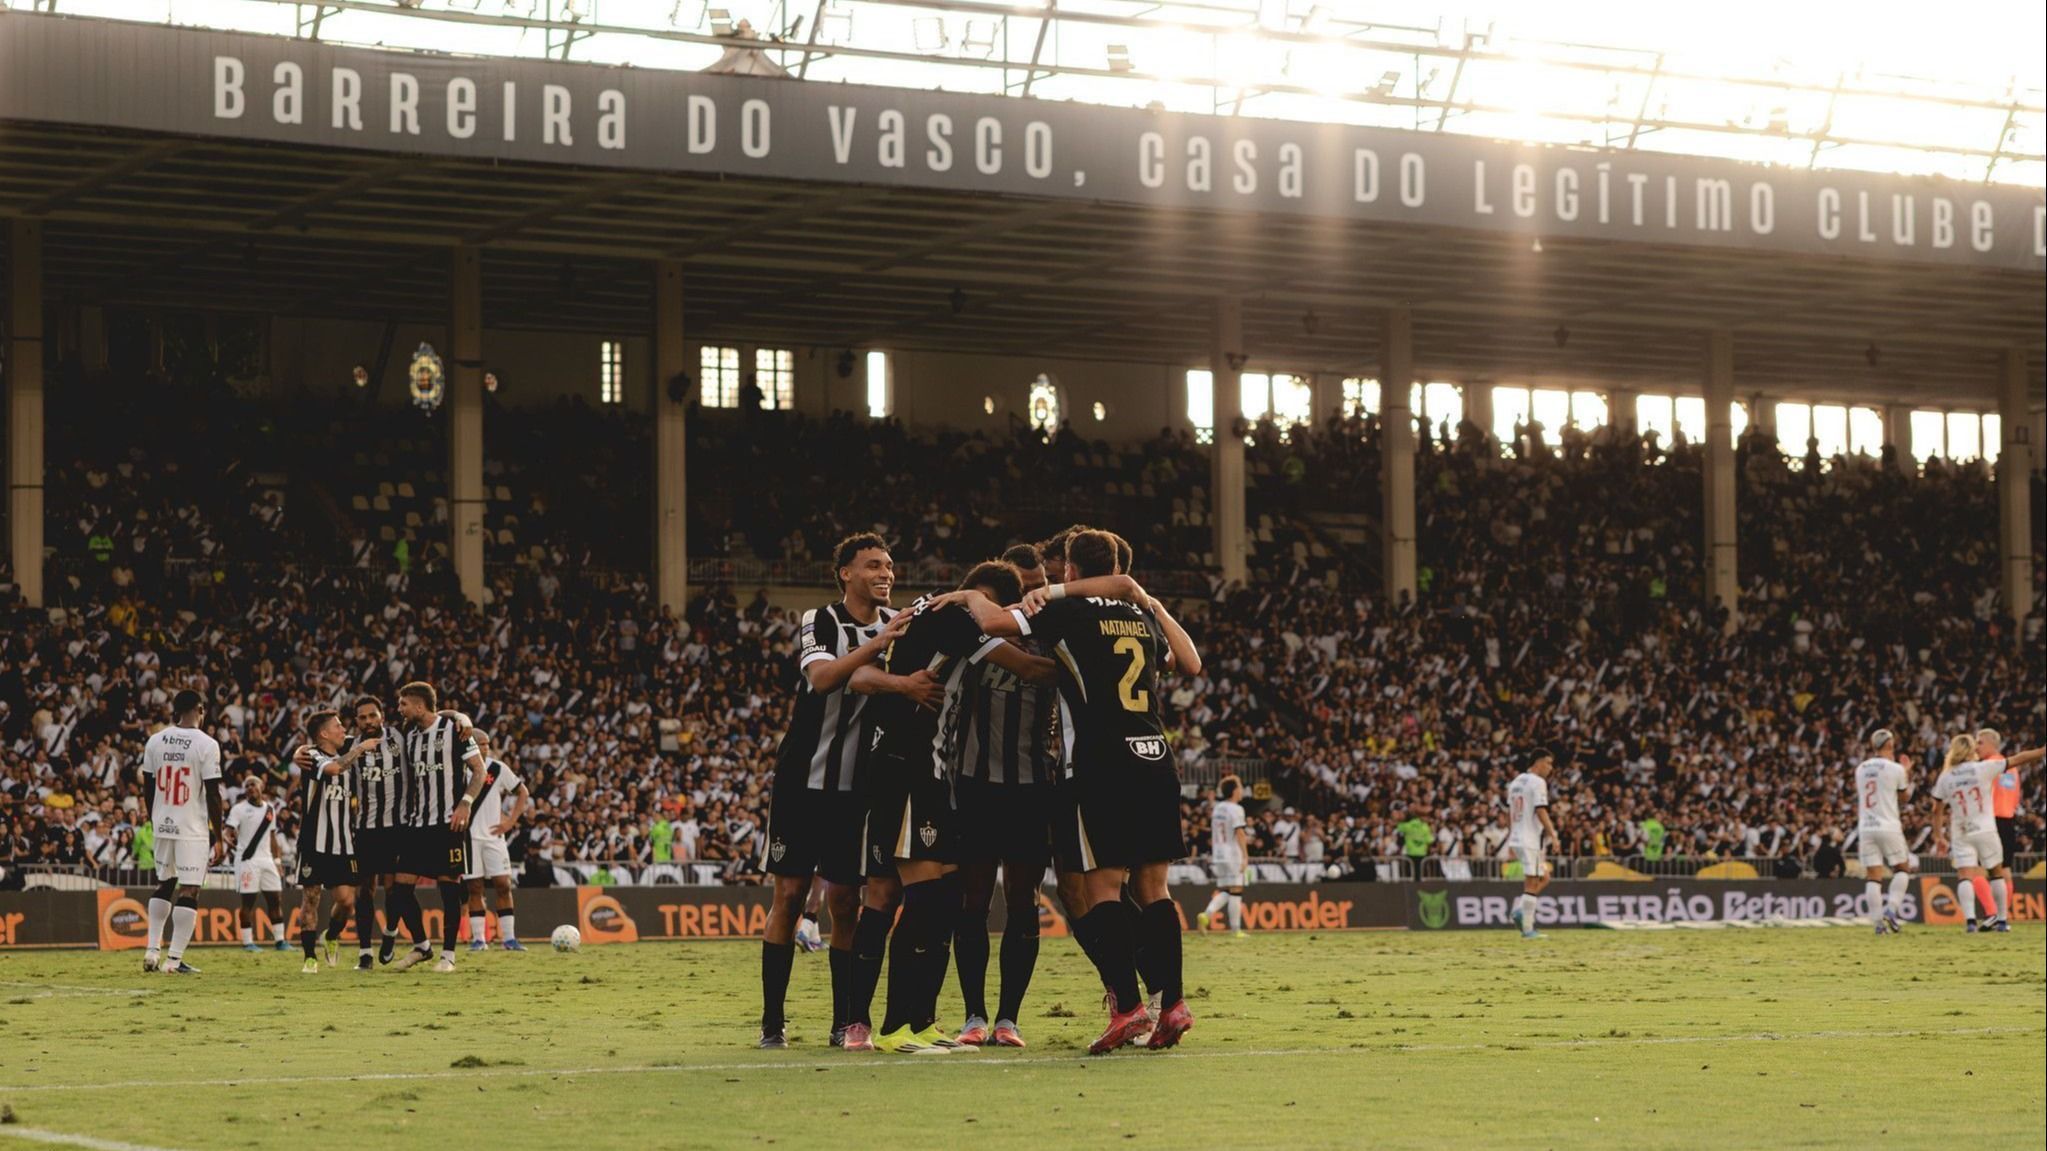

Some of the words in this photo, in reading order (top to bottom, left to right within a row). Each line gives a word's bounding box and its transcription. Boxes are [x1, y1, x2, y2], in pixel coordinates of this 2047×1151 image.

[688, 95, 772, 158] DO
[1355, 148, 1425, 207] DO
[1100, 620, 1150, 637] NATANAEL
[1113, 637, 1149, 712] 2
[1136, 741, 1160, 755] BH
[156, 765, 190, 806] 46
[1865, 779, 1878, 809] 2
[449, 848, 462, 863] 13
[658, 904, 768, 937] TRENA
[1240, 890, 1353, 929] vonder
[1724, 891, 1826, 921] Betano
